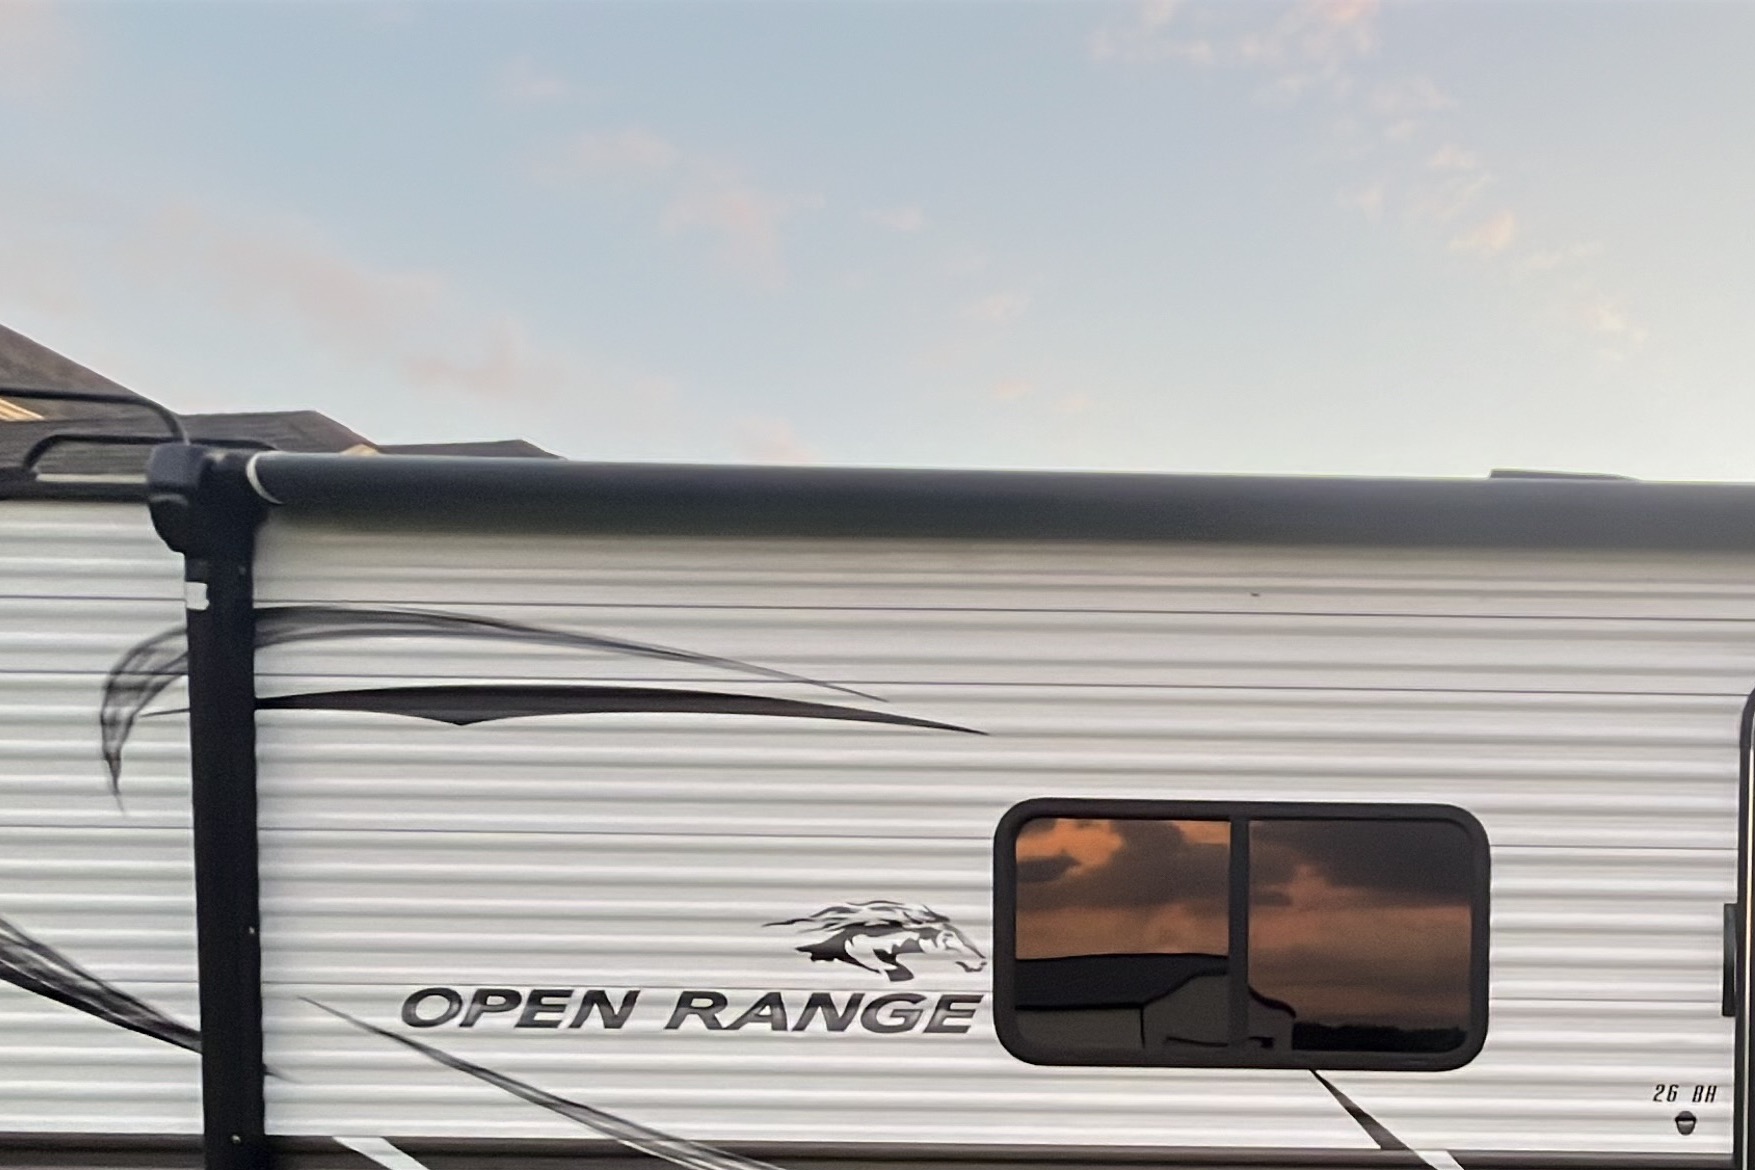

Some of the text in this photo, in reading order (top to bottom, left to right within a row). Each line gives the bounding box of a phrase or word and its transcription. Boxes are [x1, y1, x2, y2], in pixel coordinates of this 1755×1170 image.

[400, 986, 984, 1035] OPEN RANGE
[1652, 1083, 1718, 1103] 26 BH
